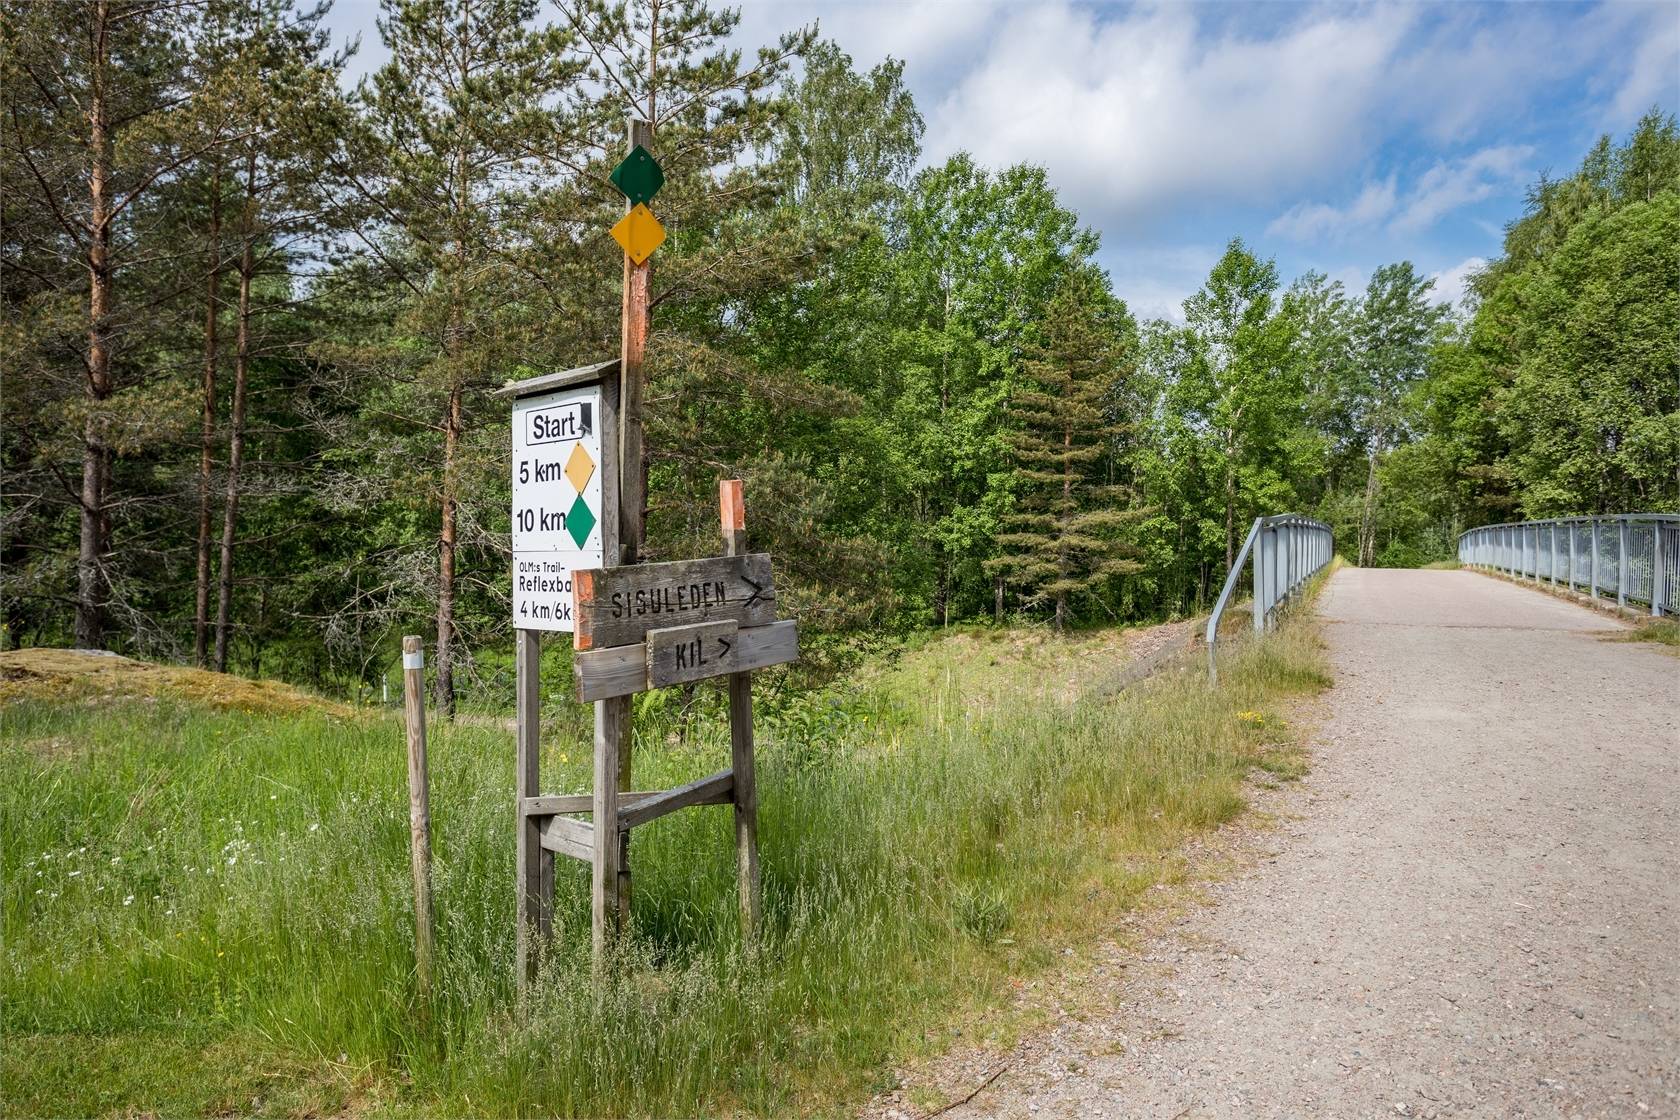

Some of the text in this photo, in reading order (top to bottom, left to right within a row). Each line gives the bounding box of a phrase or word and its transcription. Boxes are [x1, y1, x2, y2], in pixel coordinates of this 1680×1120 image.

[533, 411, 576, 440] Start
[519, 459, 561, 484] 5 km
[516, 507, 566, 532] 10 km
[519, 561, 566, 573] OLM:s Trail-
[520, 600, 528, 618] 4
[611, 581, 727, 619] SISULEDEN
[676, 636, 707, 671] KIL
